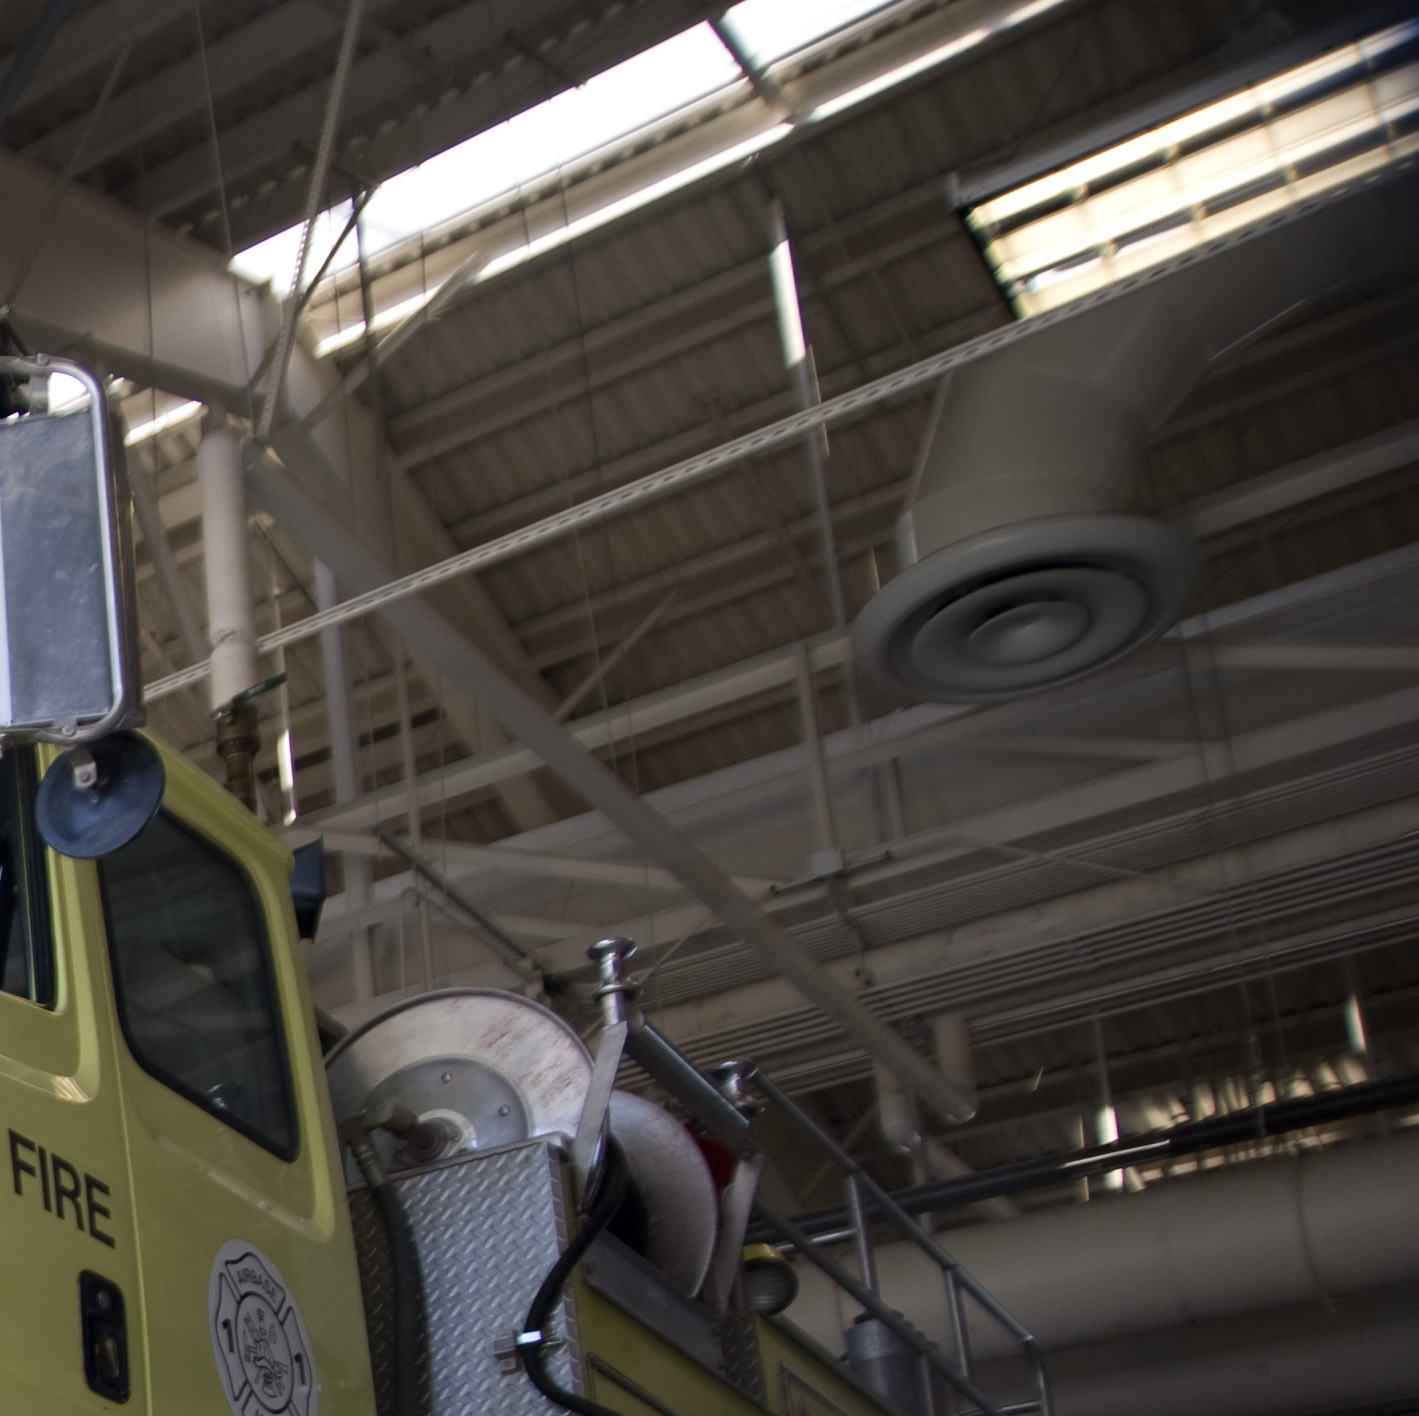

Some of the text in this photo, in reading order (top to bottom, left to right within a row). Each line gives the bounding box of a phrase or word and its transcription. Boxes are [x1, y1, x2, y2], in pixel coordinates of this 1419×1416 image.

[6, 1128, 116, 1249] FIRE
[222, 1318, 235, 1353] 1
[294, 1352, 306, 1386] 1
